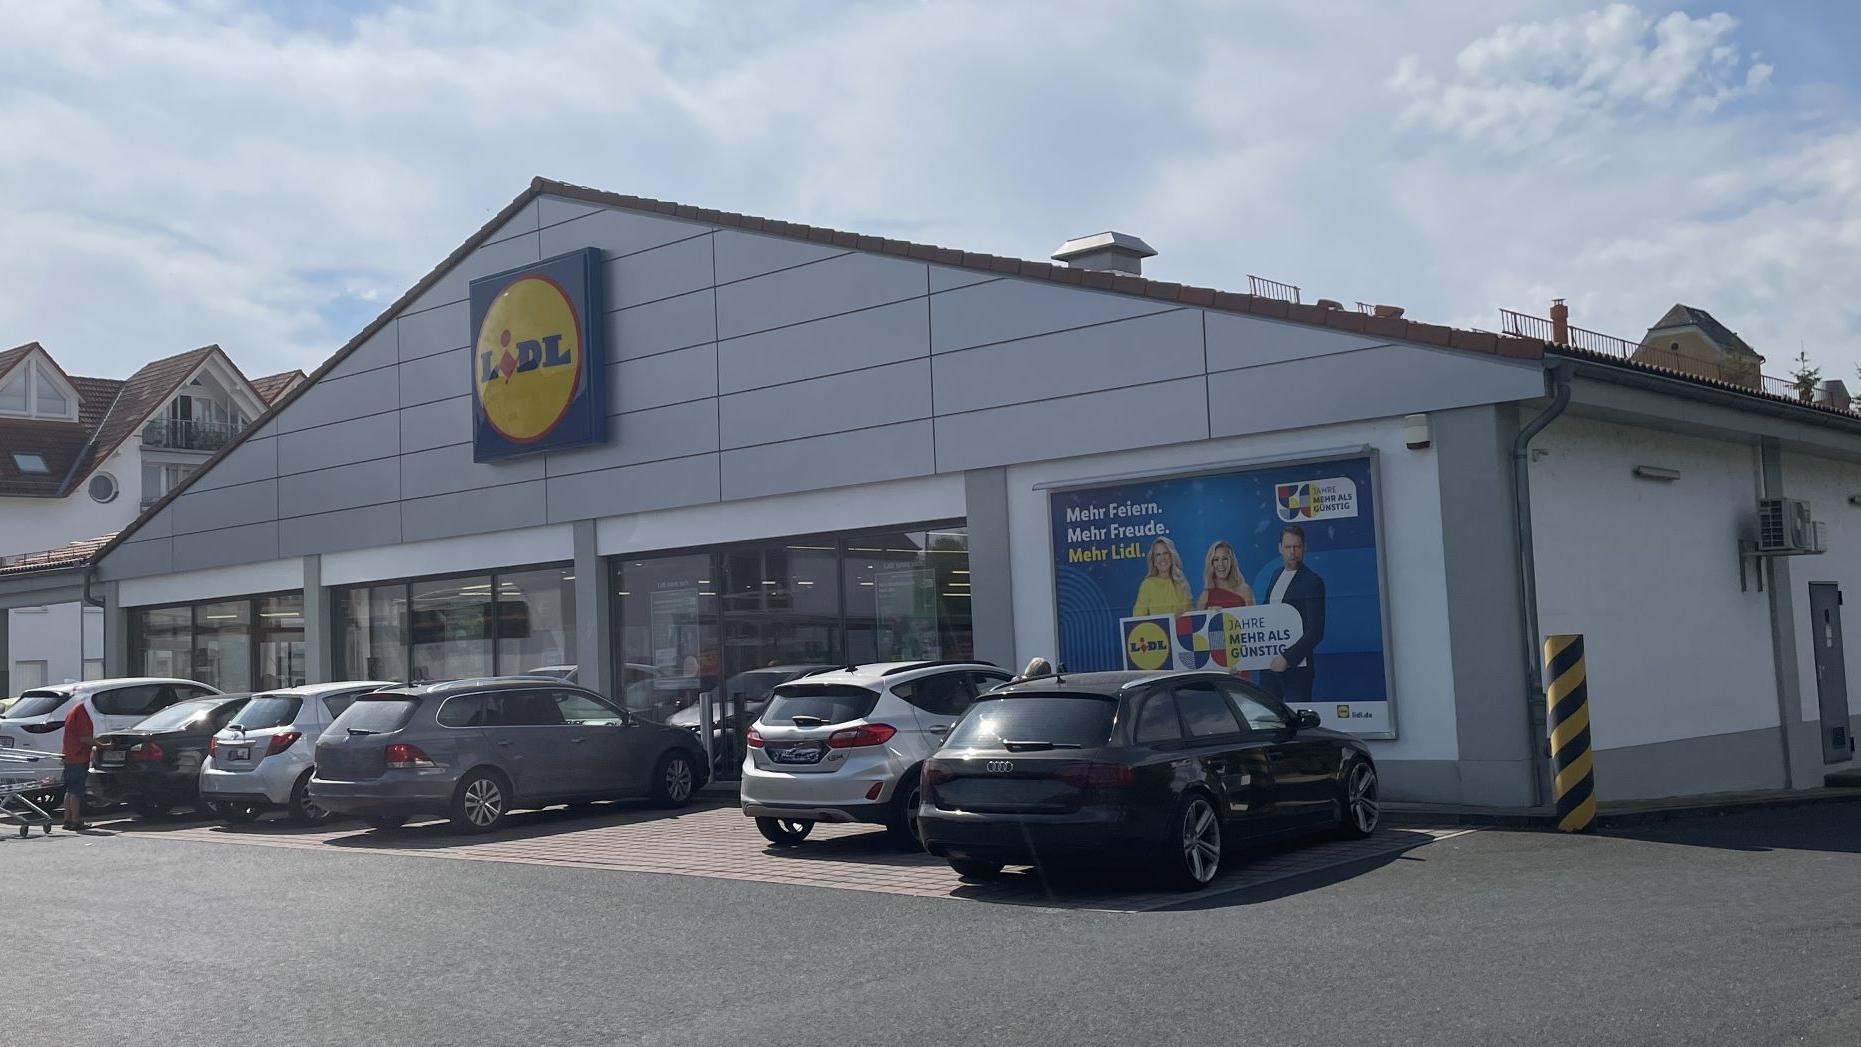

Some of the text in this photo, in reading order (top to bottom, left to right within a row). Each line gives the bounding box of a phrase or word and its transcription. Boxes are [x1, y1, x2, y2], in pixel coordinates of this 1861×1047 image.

[1313, 486, 1337, 495] JAHRE
[1313, 493, 1353, 504] MEHR ALS
[1066, 501, 1162, 523] Mehr Feiern.
[1313, 502, 1351, 513] GÜNSTIG
[1067, 520, 1169, 543] Mehr Freude.
[1068, 543, 1146, 563] Mehr Lidl.
[1228, 618, 1265, 631] JAHRE
[1229, 629, 1290, 644] MEHR ALS
[1231, 643, 1287, 659] GÜNSTIG
